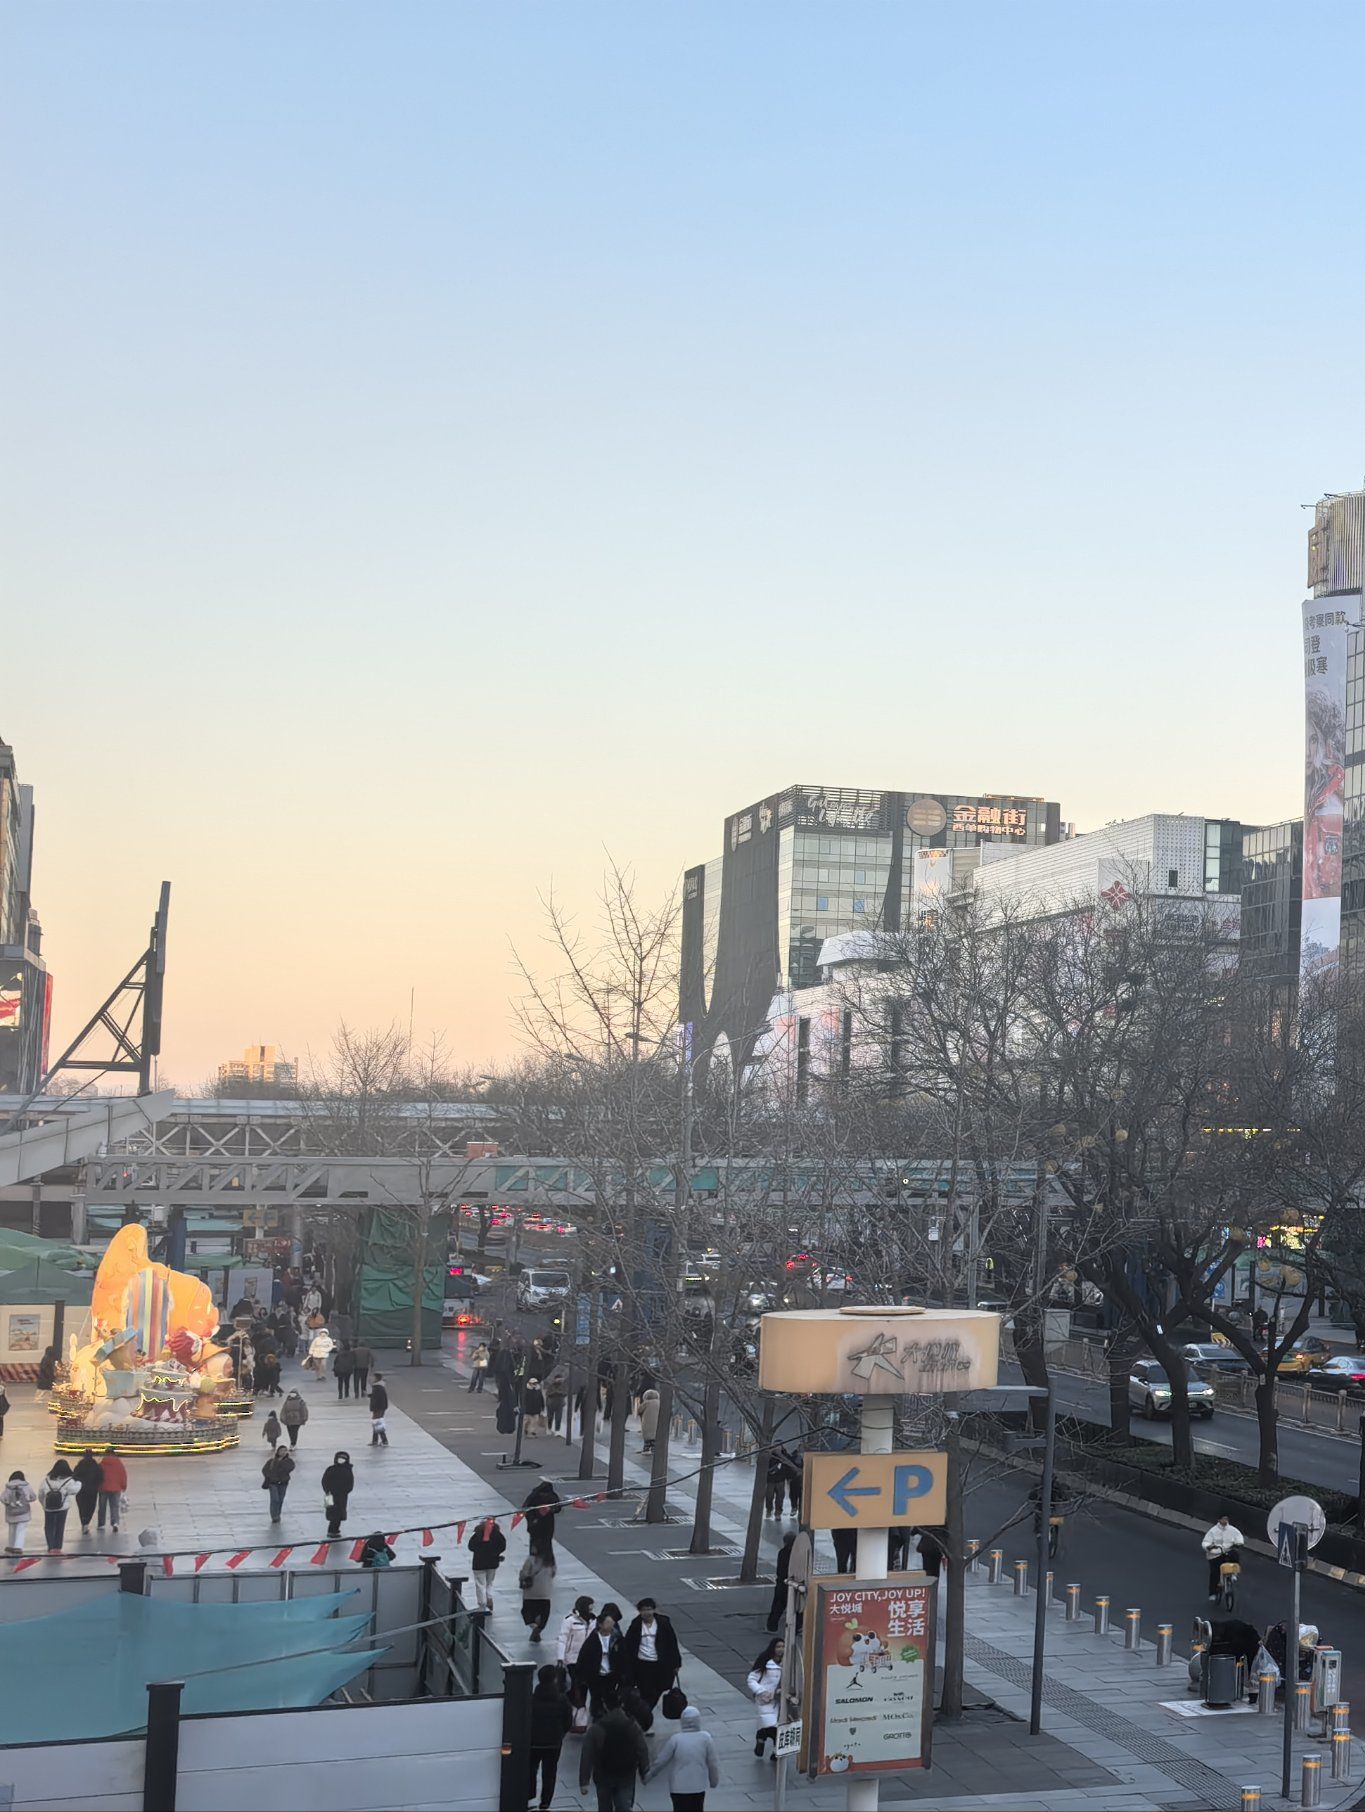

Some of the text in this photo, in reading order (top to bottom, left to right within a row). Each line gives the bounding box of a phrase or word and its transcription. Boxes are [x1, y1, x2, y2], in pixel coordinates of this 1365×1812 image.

[953, 804, 1027, 826] 金融街
[953, 823, 1026, 836] 西单购物中心
[893, 1464, 934, 1516] P
[830, 1592, 852, 1603] JOY
[906, 1588, 926, 1599] UP!
[830, 1602, 863, 1615] 大悦城
[888, 1600, 926, 1619] 悦享
[887, 1618, 926, 1637] 生活
[835, 1696, 874, 1705] SALOMON
